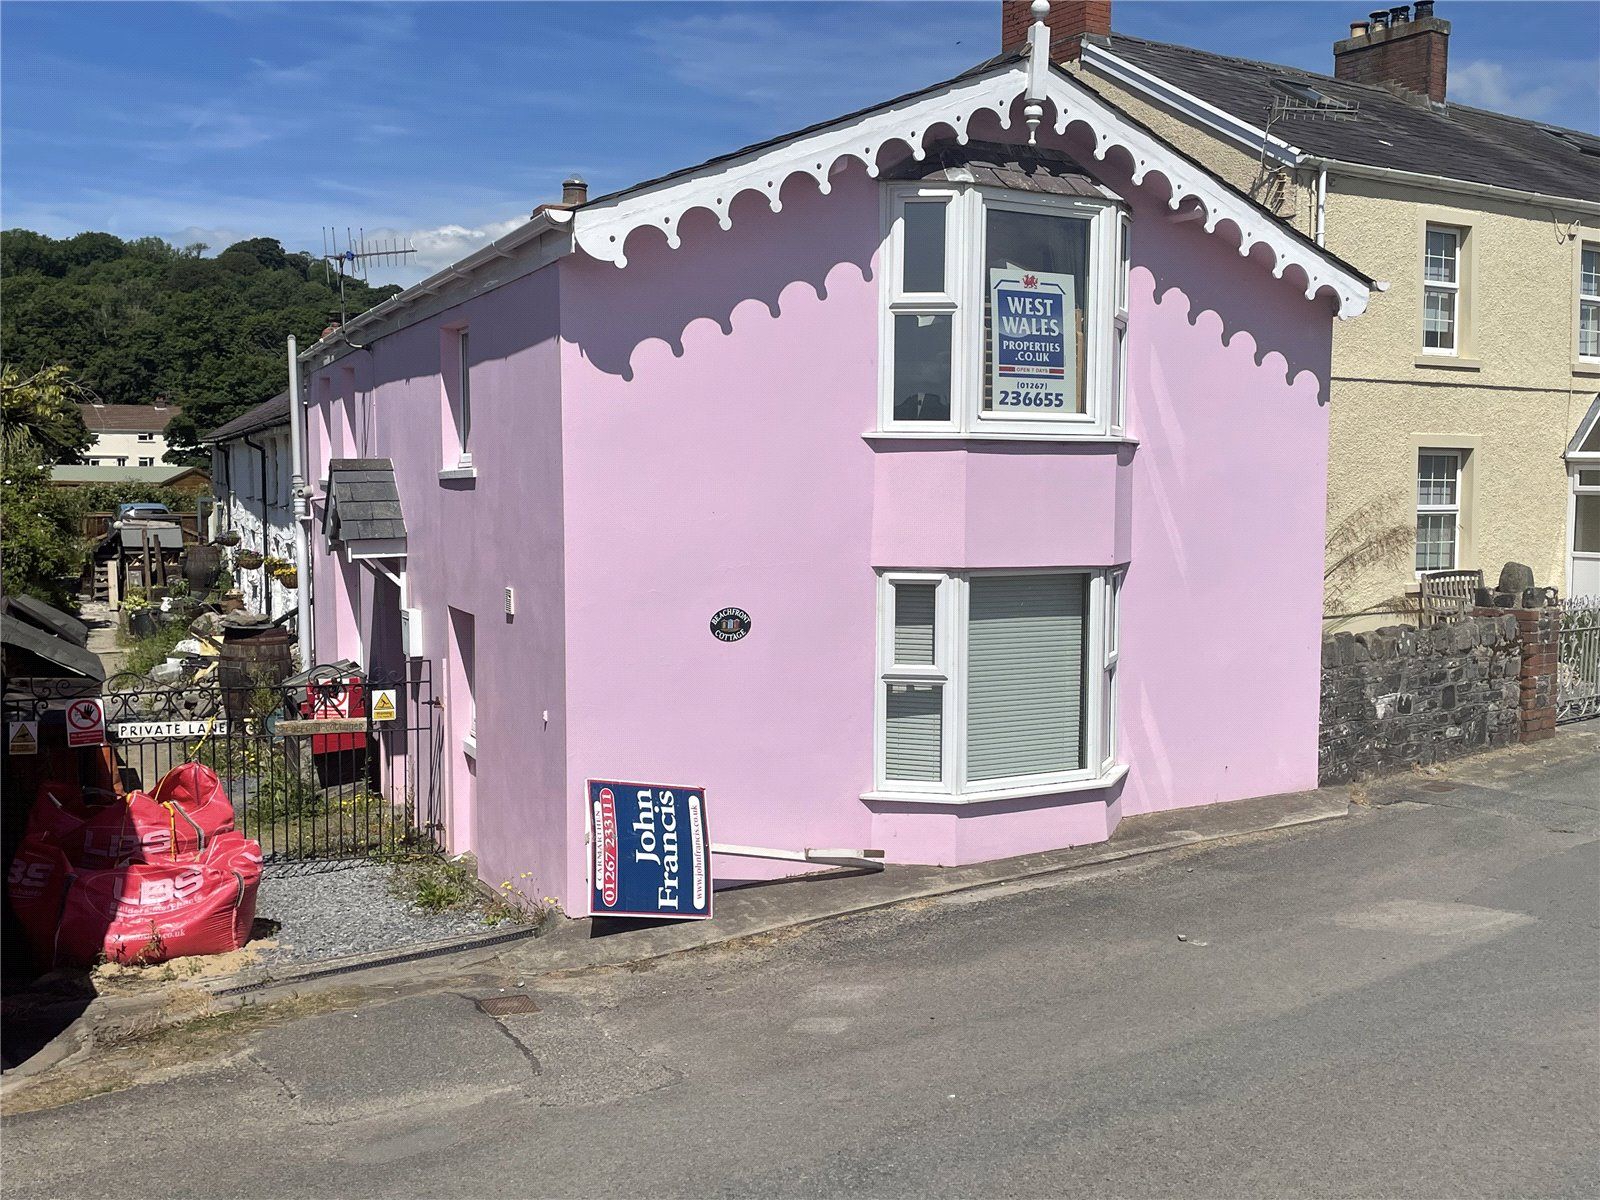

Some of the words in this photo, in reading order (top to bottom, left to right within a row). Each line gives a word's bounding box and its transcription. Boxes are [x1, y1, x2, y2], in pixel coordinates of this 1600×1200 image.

[1006, 296, 1053, 316] WEST
[1002, 316, 1060, 337] WALES
[1003, 340, 1061, 352] PROPERTIES
[1015, 351, 1050, 362] .CO.UK
[999, 390, 1064, 408] 236655
[1017, 381, 1048, 390] (01267)
[714, 628, 747, 641] COTTAGE
[120, 724, 181, 736] PRIVATE
[188, 722, 226, 735] LANE
[601, 793, 616, 848] 233111
[632, 788, 661, 866] John
[84, 829, 172, 857] LBS
[595, 811, 603, 881] CARMARTHEN
[654, 790, 679, 910] Francis
[691, 805, 703, 900] www.johnfrancis.co.uk
[8, 858, 55, 888] BS
[604, 852, 616, 902] 01267
[113, 870, 205, 906] LBS
